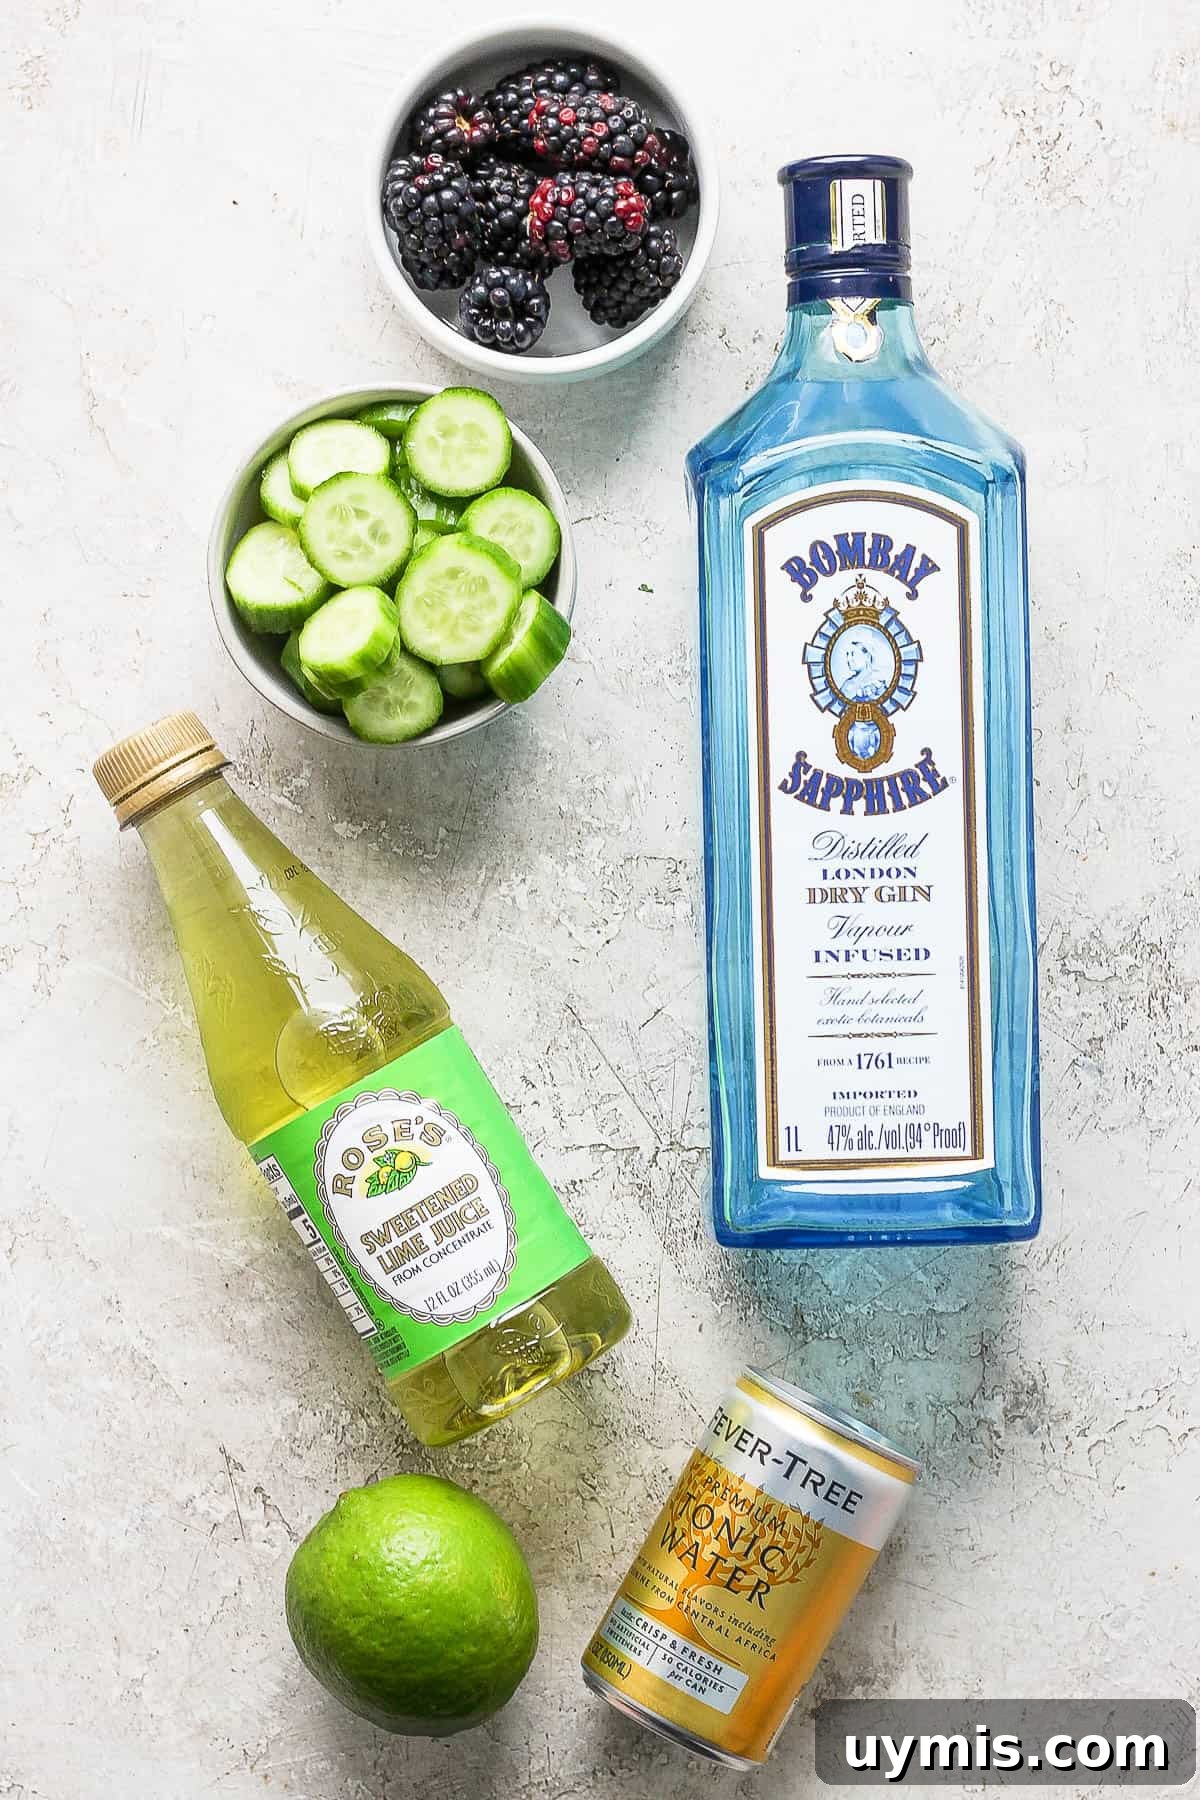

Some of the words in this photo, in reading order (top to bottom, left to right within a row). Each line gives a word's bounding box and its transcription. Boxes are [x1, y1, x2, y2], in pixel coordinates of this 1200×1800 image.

[780, 532, 940, 603] BOMBAY
[778, 747, 949, 816] SAPPHIRE
[808, 830, 929, 861] Distilled
[806, 887, 870, 904] DRY
[874, 885, 934, 903] GIN
[822, 867, 917, 880] LONDON
[827, 914, 914, 945] Vapour
[814, 948, 931, 963] INFUSED
[817, 1014, 855, 1025] exotic
[857, 1007, 928, 1025] botanicals
[819, 987, 871, 1006] Hand
[817, 1057, 844, 1067] FROM
[846, 1057, 853, 1066] A
[856, 1052, 894, 1070] 1761
[896, 1056, 931, 1065] RECIPE
[824, 1105, 865, 1117] PRODUCT
[869, 1105, 881, 1116] OF
[884, 1104, 925, 1116] ENGLAND
[832, 1089, 918, 1100] IMPORTED
[332, 1116, 446, 1198] ROSE'S
[827, 1124, 853, 1151] 47%
[360, 1173, 479, 1256] SWEETENED
[377, 1232, 430, 1275] LIME
[429, 1197, 490, 1246] JUICE
[392, 1265, 423, 1286] FROM
[423, 1221, 495, 1268] CONCENTRATE
[424, 1296, 437, 1312] 12
[435, 1290, 449, 1307] FL
[447, 1282, 464, 1300] OZ
[462, 1270, 484, 1293] (355
[707, 1406, 864, 1515] FEVER-TREE
[702, 1476, 785, 1535] PREMIUM
[678, 1492, 786, 1574] TONIC
[660, 1522, 771, 1611] WATER
[651, 1584, 674, 1604] FROM
[677, 1601, 730, 1638] CENTRAL
[735, 1637, 777, 1662] AFRICA
[682, 1587, 726, 1618] FLAVORS
[728, 1612, 777, 1645] including
[635, 1617, 668, 1641] CRISP
[669, 1640, 678, 1650] &
[680, 1648, 724, 1676] FRESH
[666, 1669, 684, 1682] per
[685, 1675, 707, 1695] CAN
[676, 1661, 725, 1693] CALORIES
